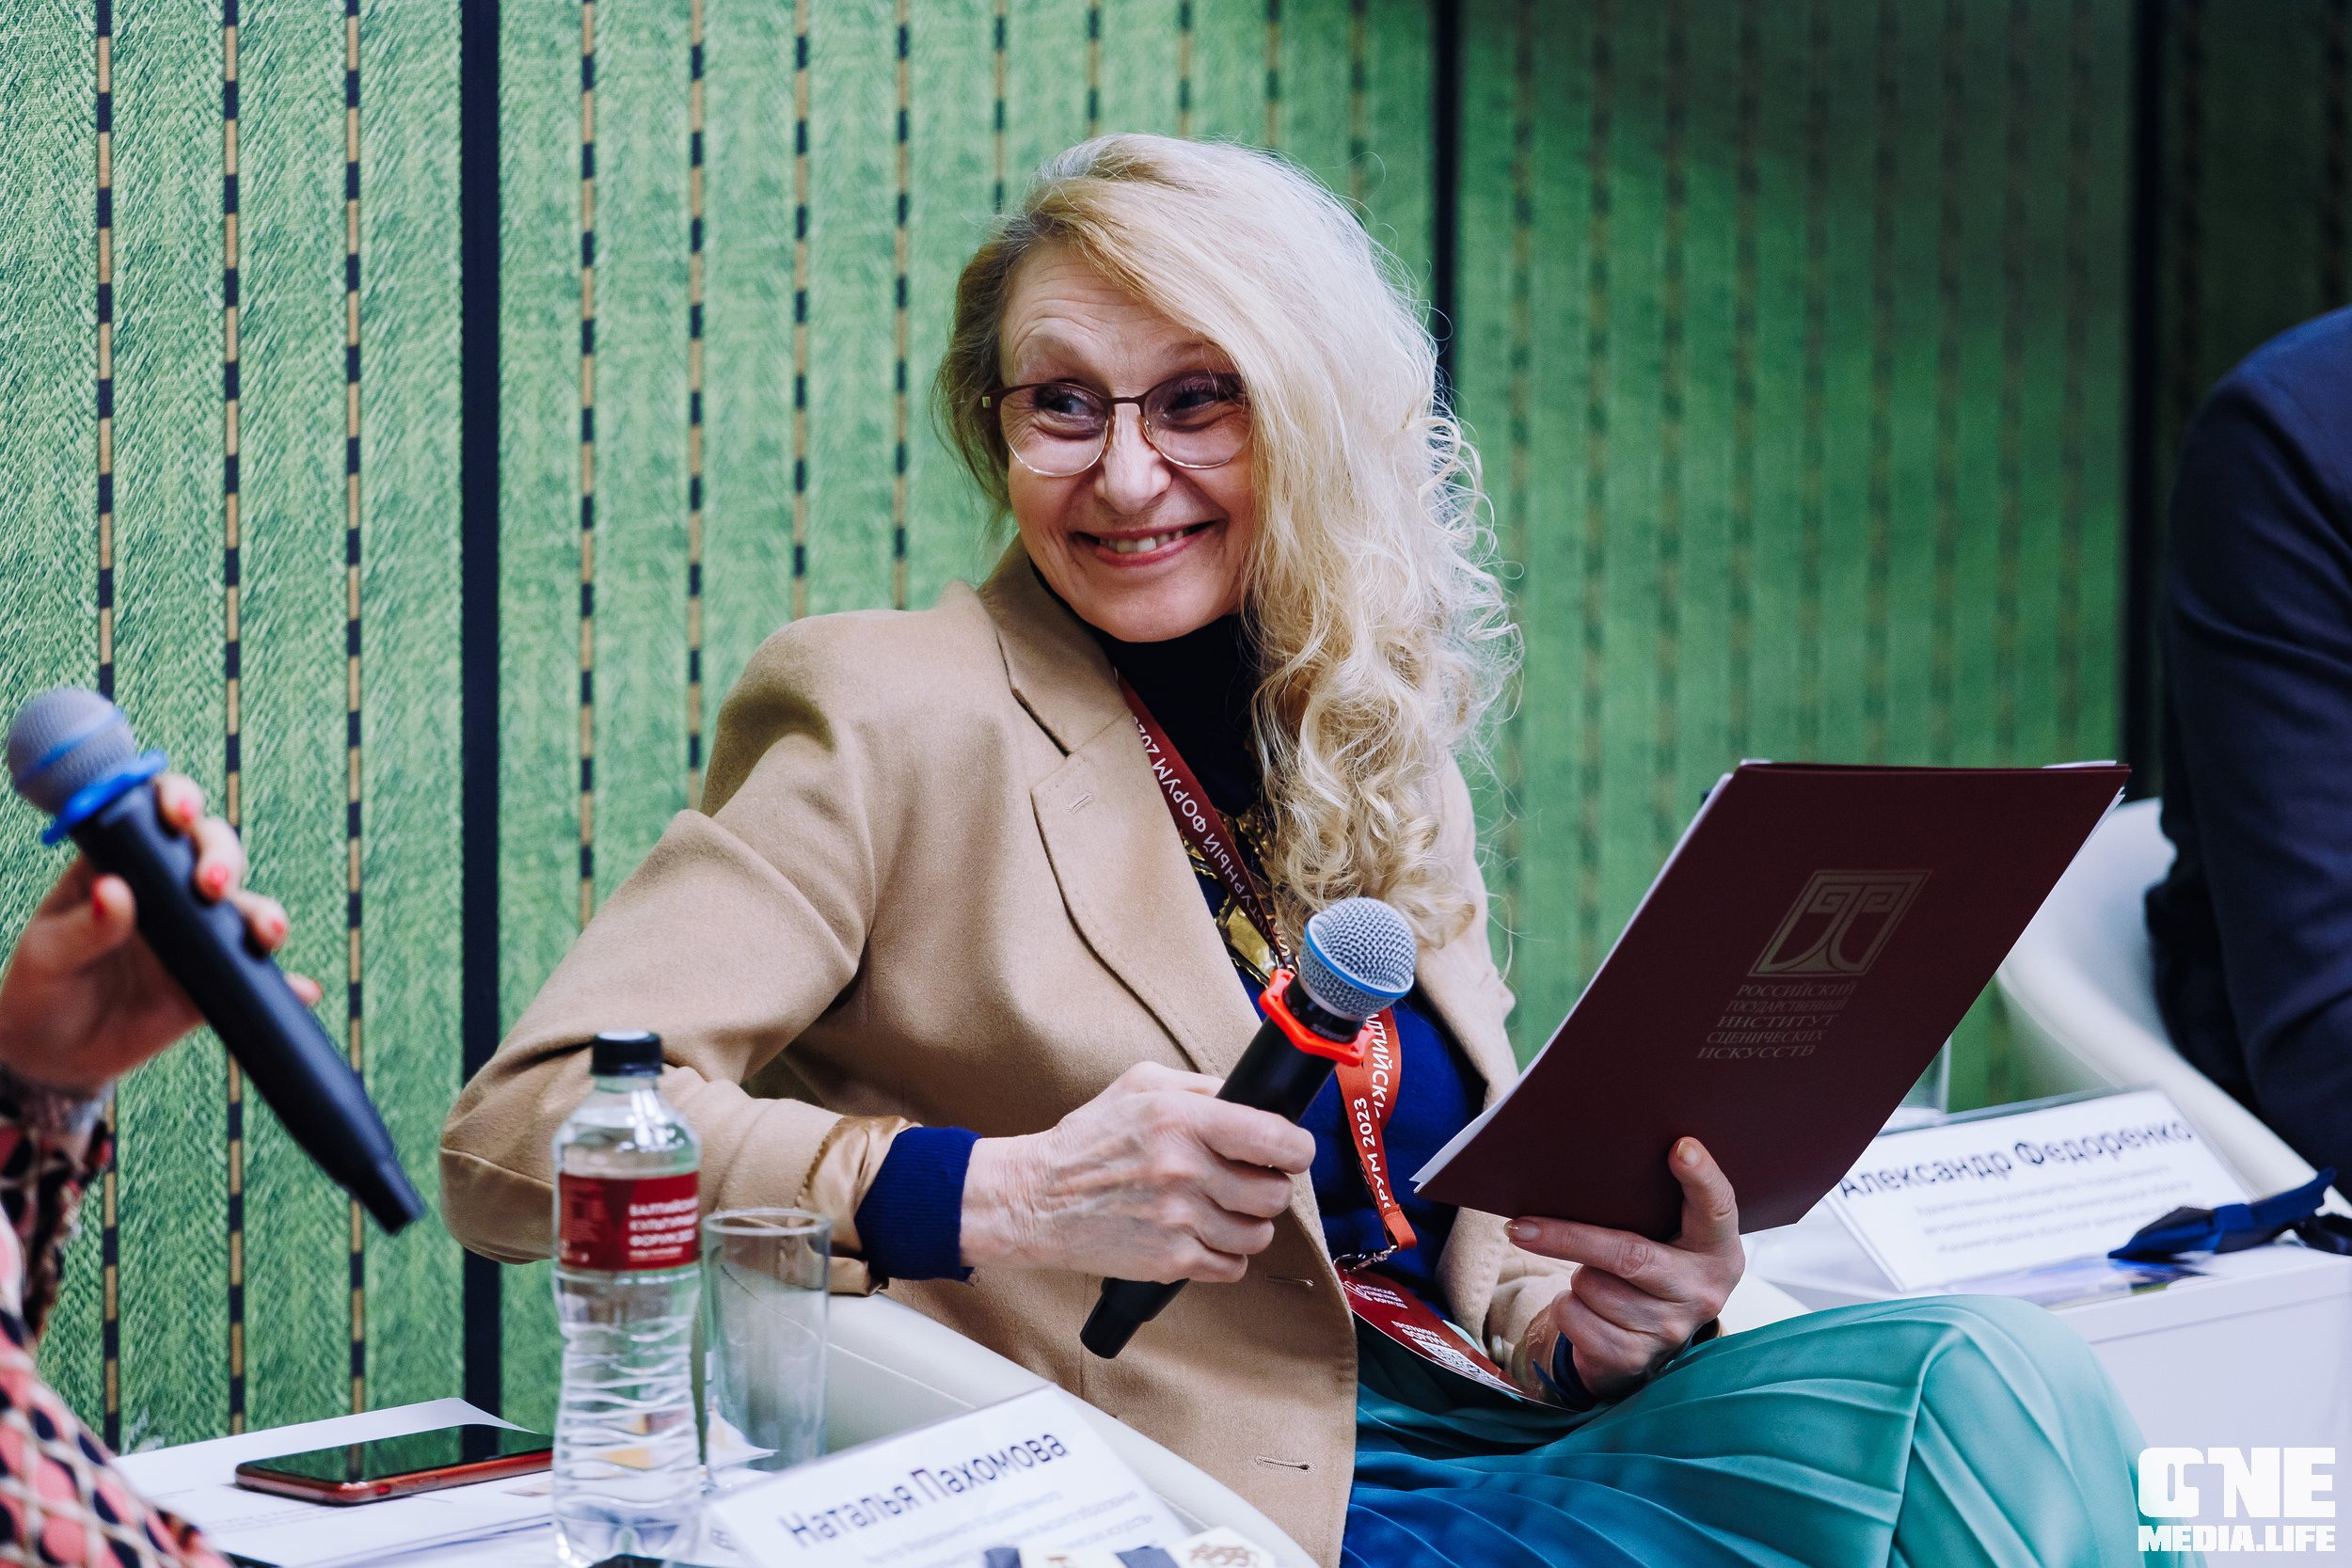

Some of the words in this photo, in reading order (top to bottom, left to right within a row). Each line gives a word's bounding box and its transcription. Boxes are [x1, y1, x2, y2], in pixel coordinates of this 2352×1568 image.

[1152, 756, 1207, 833] ФОРУМ
[1737, 982, 1859, 998] РОССИЙСКИЙ
[1725, 997, 1850, 1014] ГОСУДАРСТВЕННЫЙ
[1716, 1015, 1840, 1029] ИНСТИТУТ
[1706, 1029, 1829, 1045] СЦЕНИЧЕСКИХ
[1696, 1045, 1817, 1060] ИСКУССТВ
[1354, 1097, 1376, 1148] 2023
[1838, 1149, 2014, 1199] Александр
[2013, 1118, 2194, 1167] Федоренко
[778, 1483, 923, 1548] Наталья
[909, 1433, 1071, 1505] Пахомова
